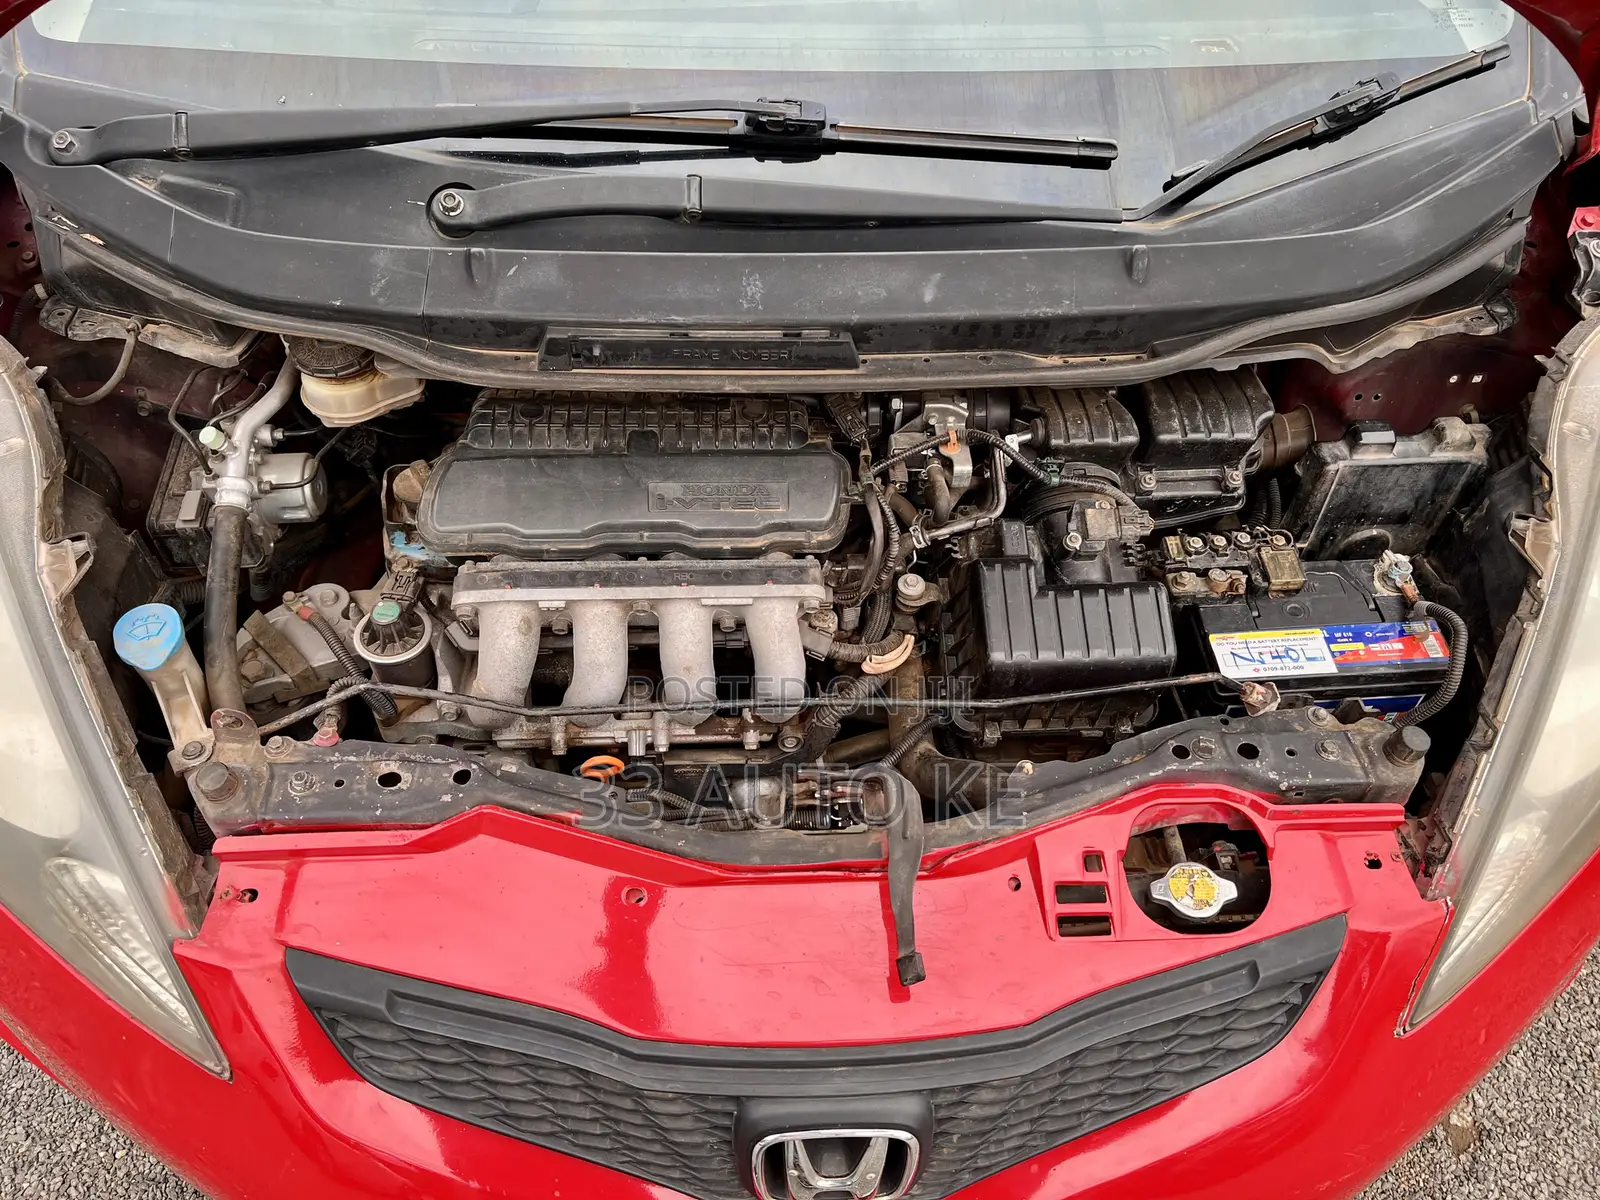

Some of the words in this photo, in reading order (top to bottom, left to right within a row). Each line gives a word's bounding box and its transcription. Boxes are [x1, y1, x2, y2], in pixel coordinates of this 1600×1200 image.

[673, 349, 720, 360] FRAME
[732, 349, 788, 361] NUMBER
[681, 484, 771, 496] HONDA
